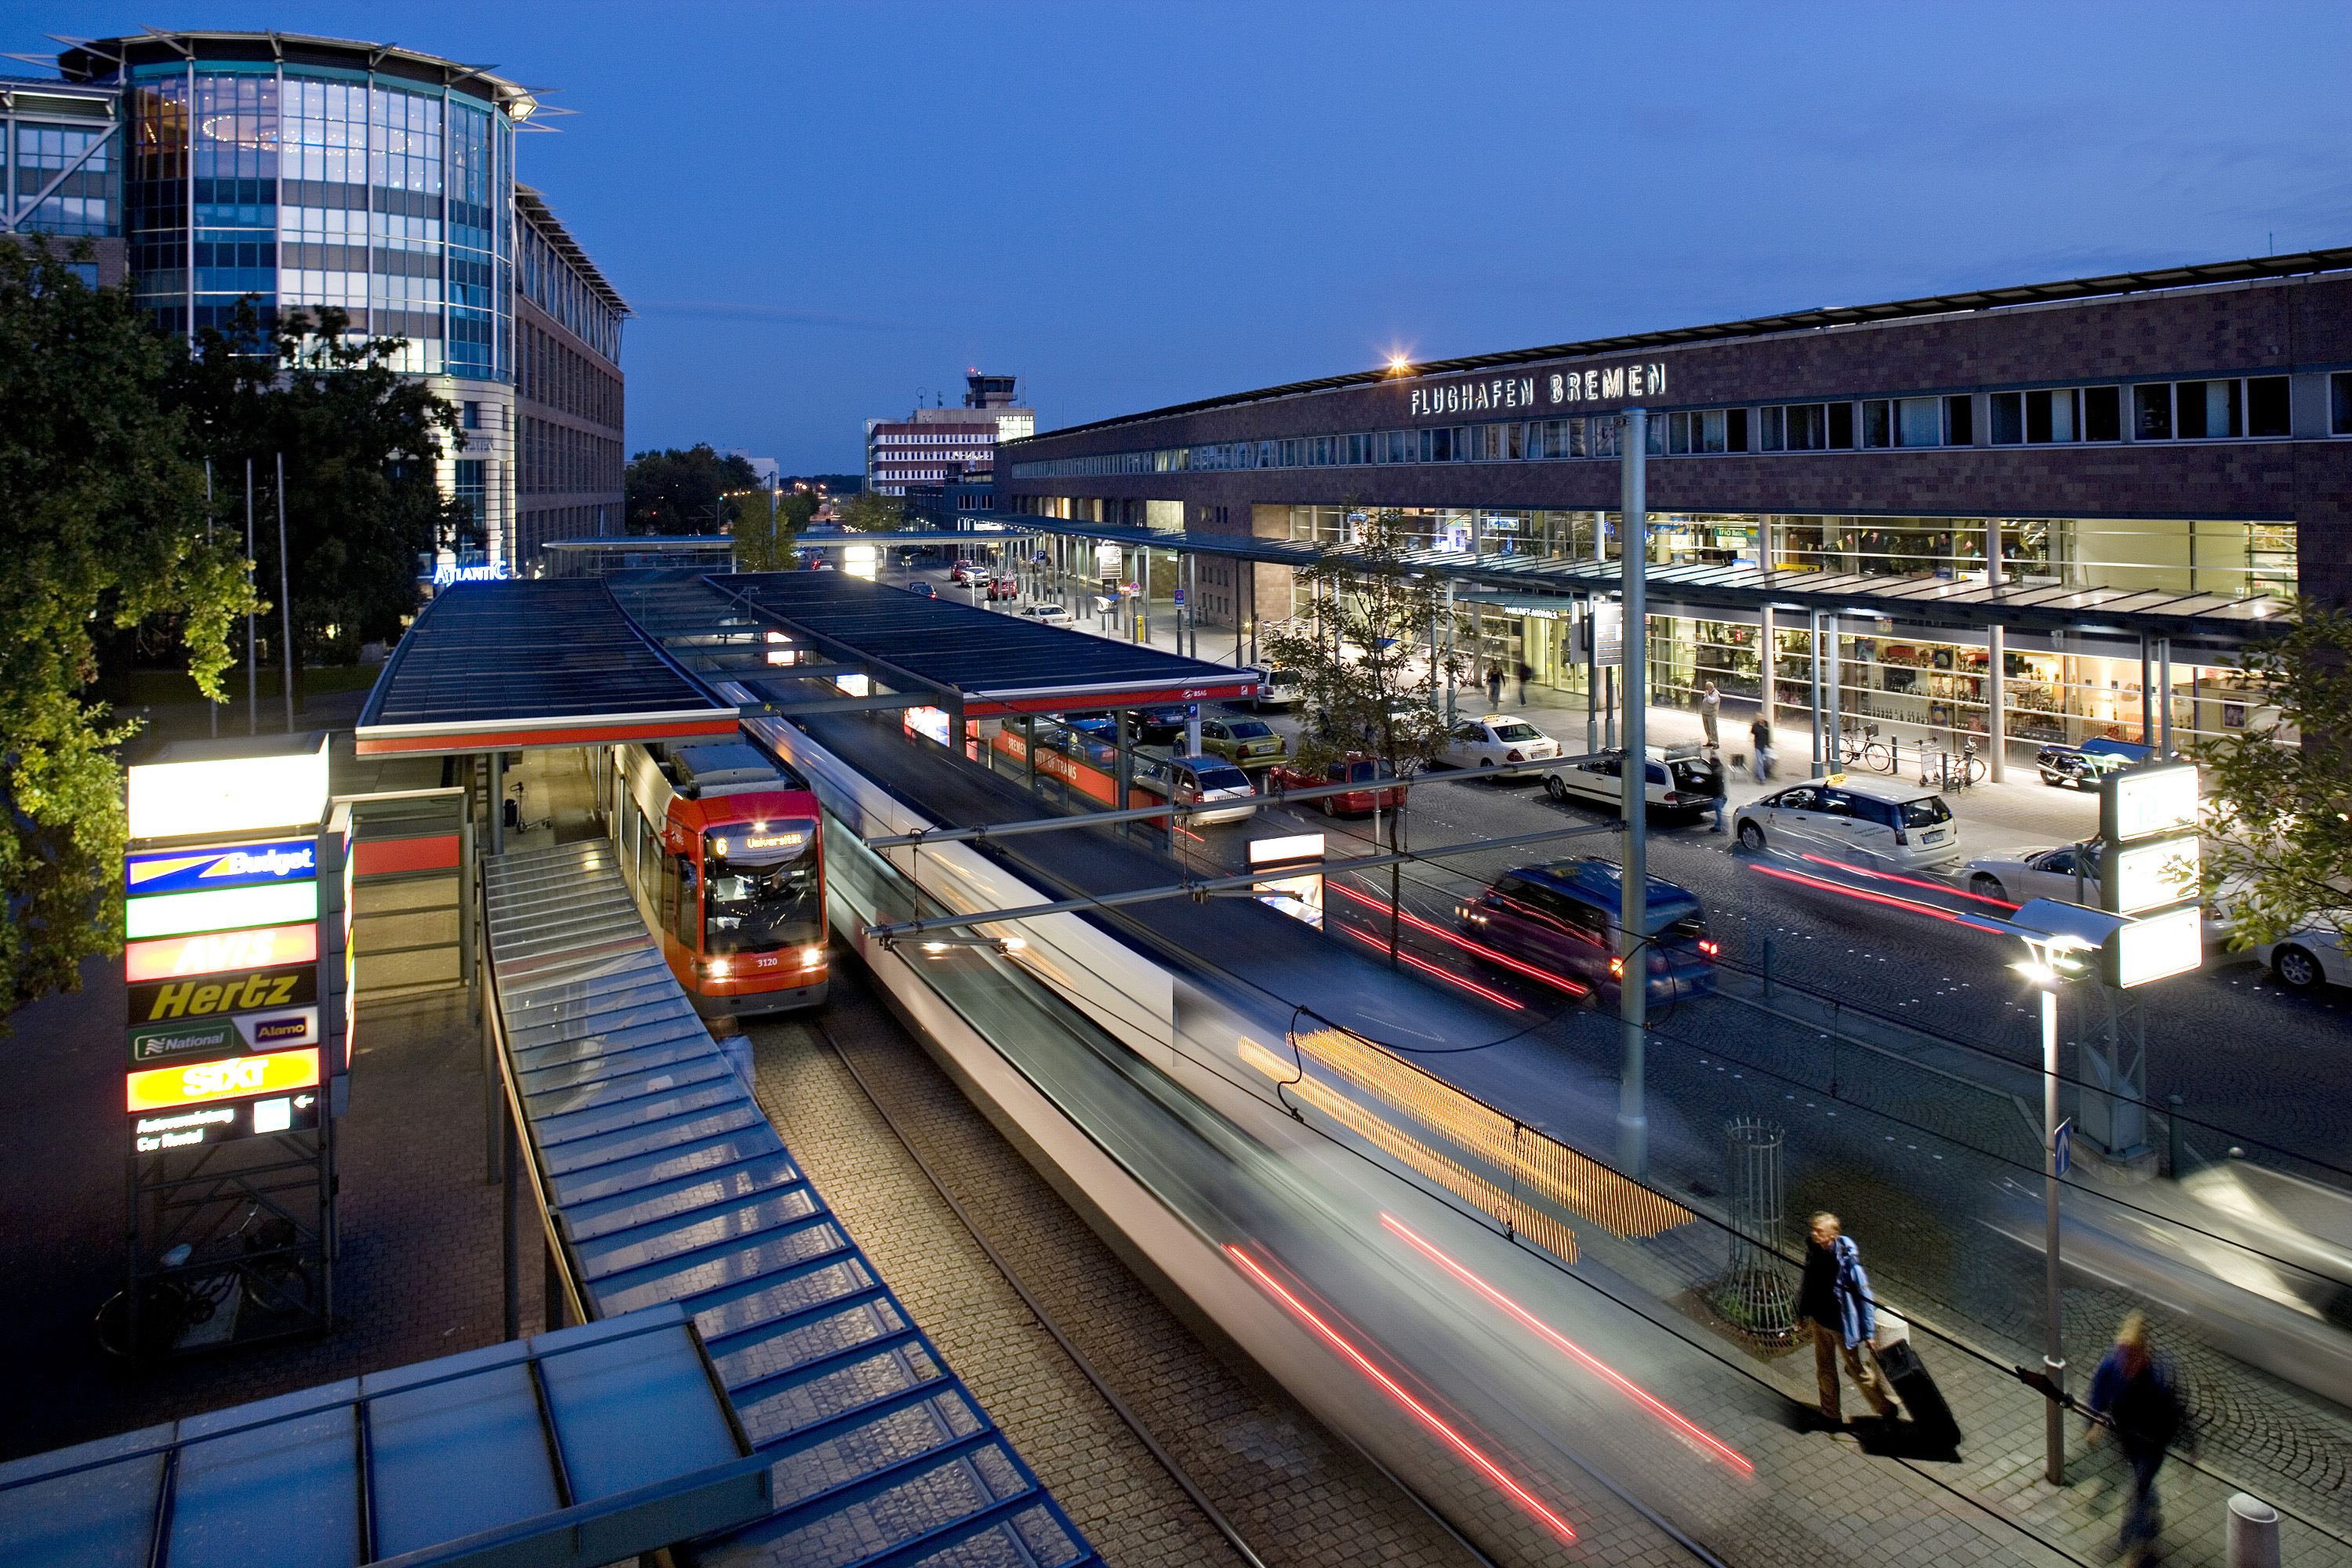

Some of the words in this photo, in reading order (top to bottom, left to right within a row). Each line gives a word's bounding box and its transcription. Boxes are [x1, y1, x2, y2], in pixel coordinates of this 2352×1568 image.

[1411, 378, 1534, 416] FLUGHAFEN
[1549, 363, 1666, 404] BREMEN
[433, 560, 509, 585] ATLANTIC
[1035, 749, 1046, 766] CITY
[1047, 755, 1055, 770] OF
[1056, 759, 1077, 780] TRAMS
[715, 837, 728, 856] 6
[746, 833, 804, 850] Universität
[229, 848, 315, 877] Budget
[172, 931, 274, 974] AVIS
[757, 956, 778, 968] 3120
[147, 972, 300, 1022] Hertz
[163, 1032, 224, 1051] National
[257, 1024, 306, 1039] Alamo
[136, 1137, 162, 1153] Car
